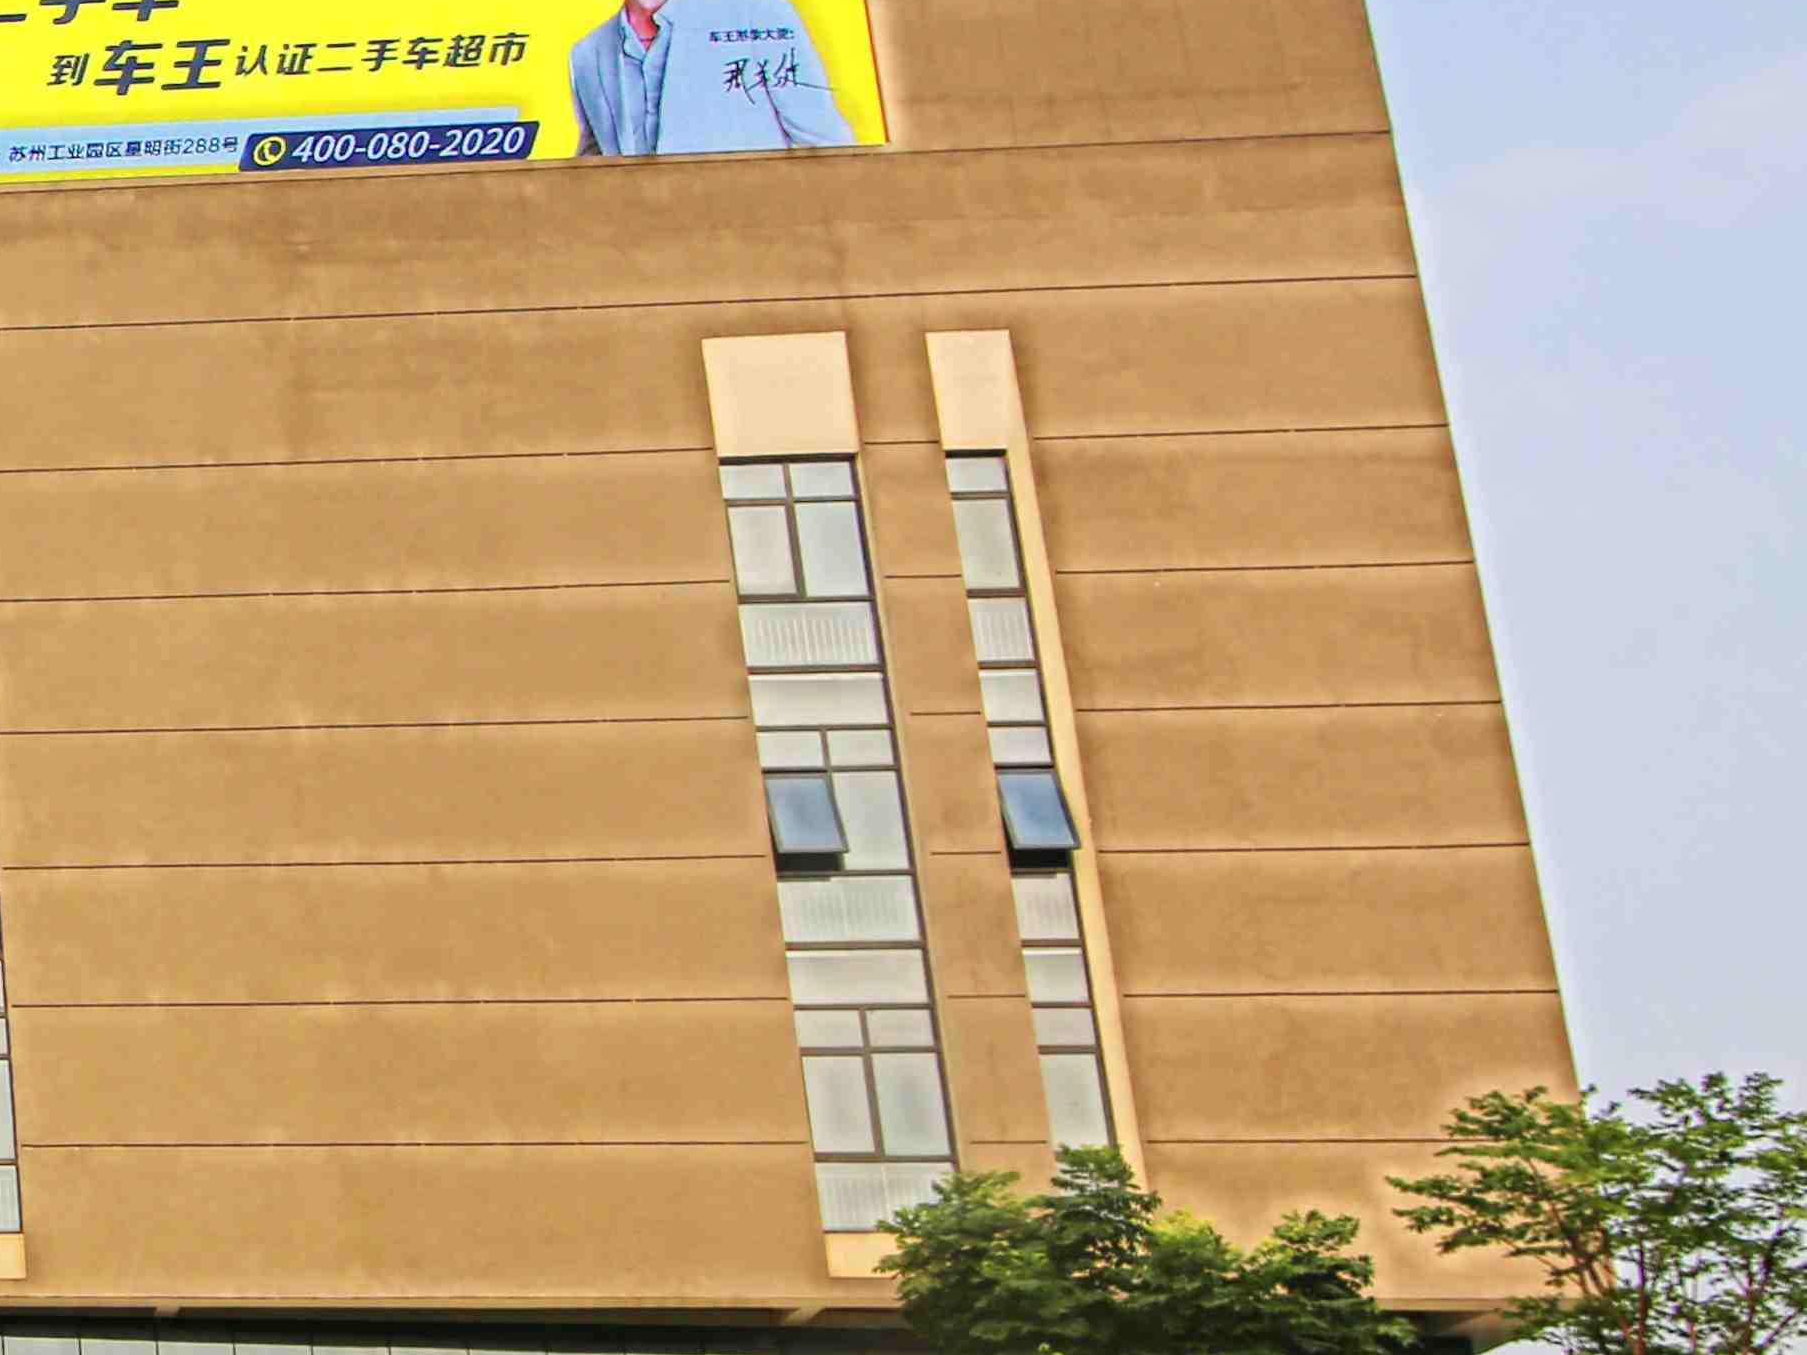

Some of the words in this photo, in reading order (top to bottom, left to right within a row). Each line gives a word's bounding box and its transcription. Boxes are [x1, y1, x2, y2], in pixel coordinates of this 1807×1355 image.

[46, 32, 531, 96] 到车王认证二手车超市
[291, 125, 526, 163] 400-080-2020
